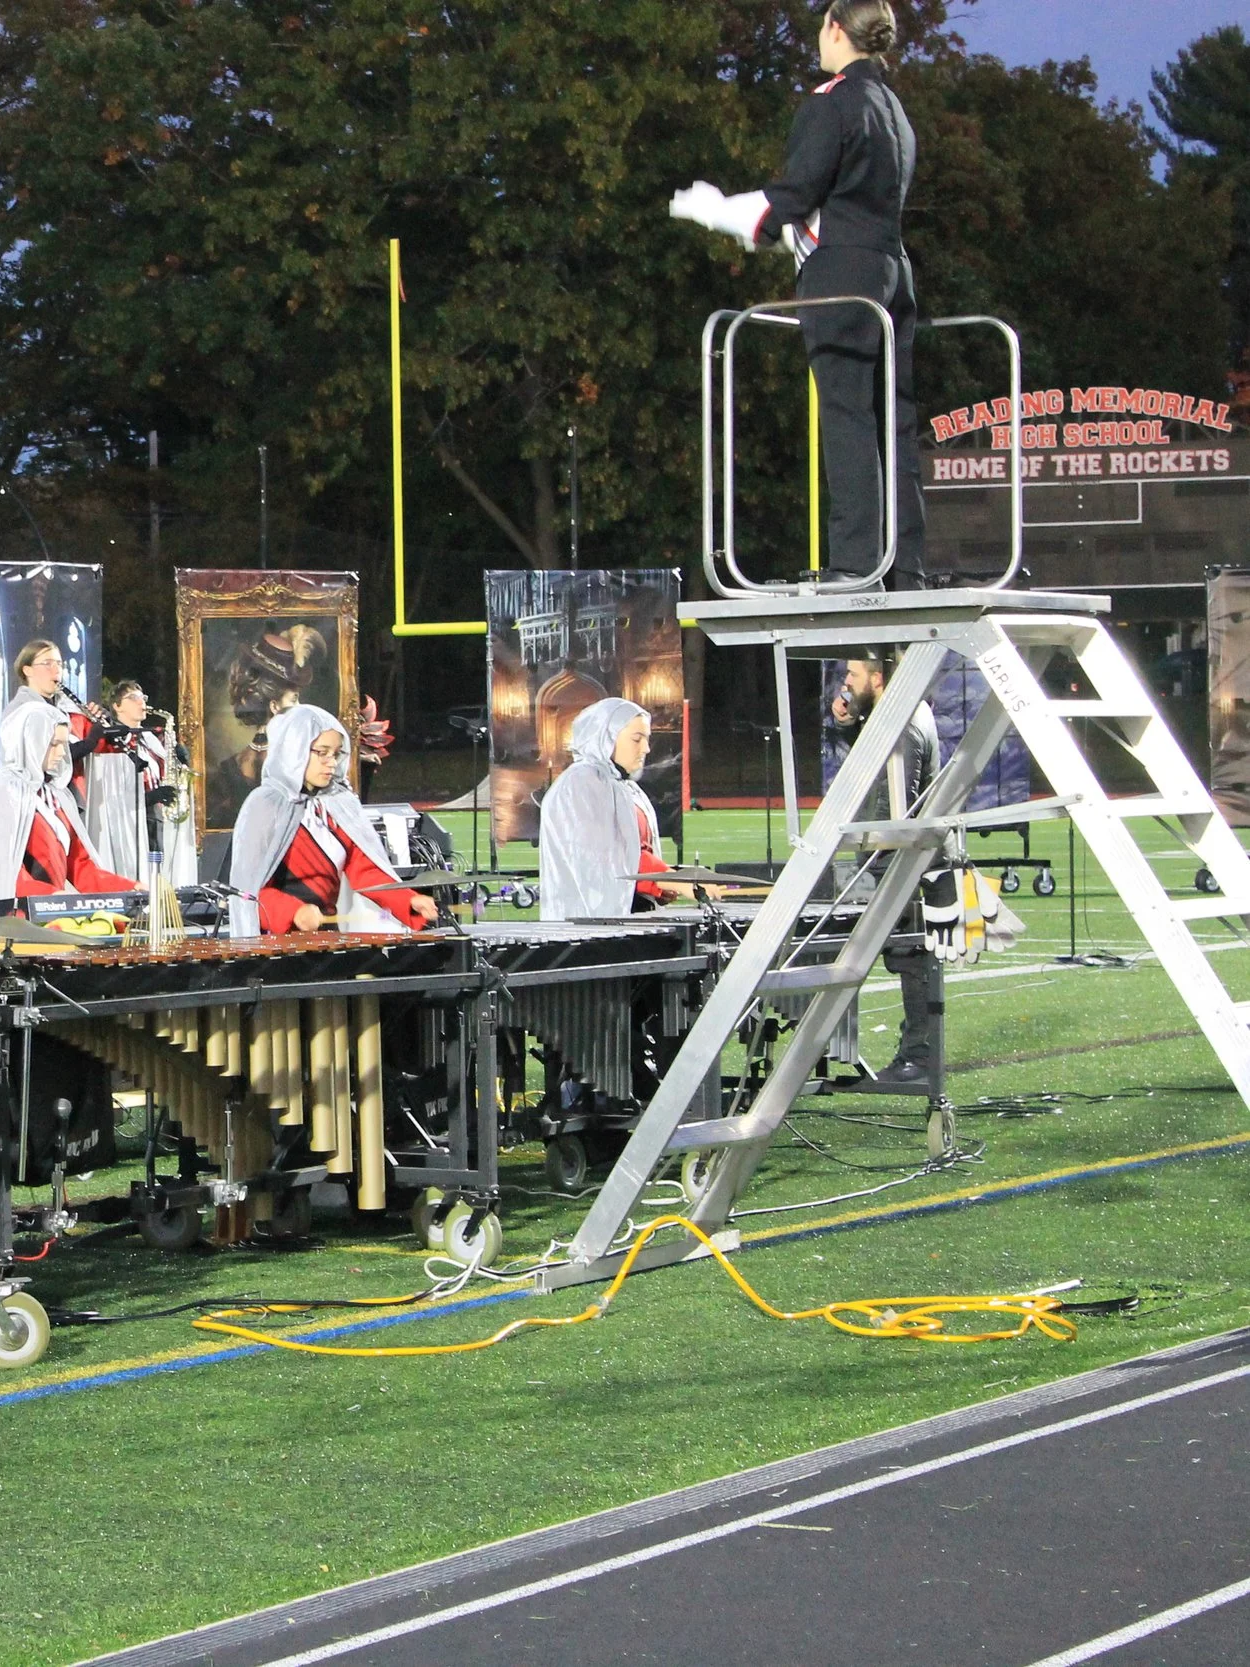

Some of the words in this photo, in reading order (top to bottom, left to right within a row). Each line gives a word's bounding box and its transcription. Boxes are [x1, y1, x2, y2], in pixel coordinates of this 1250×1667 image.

[930, 389, 1064, 442] READNG
[1070, 386, 1232, 432] MEMORIAL
[991, 424, 1057, 449] HGH
[1063, 419, 1170, 447] SCHOOL
[934, 457, 1006, 480] HOME
[1051, 453, 1102, 477] THE
[1109, 448, 1230, 475] ROCKETS
[983, 655, 1027, 713] JARVIS
[44, 901, 67, 911] Roland
[73, 898, 124, 910] JUNO-DS
